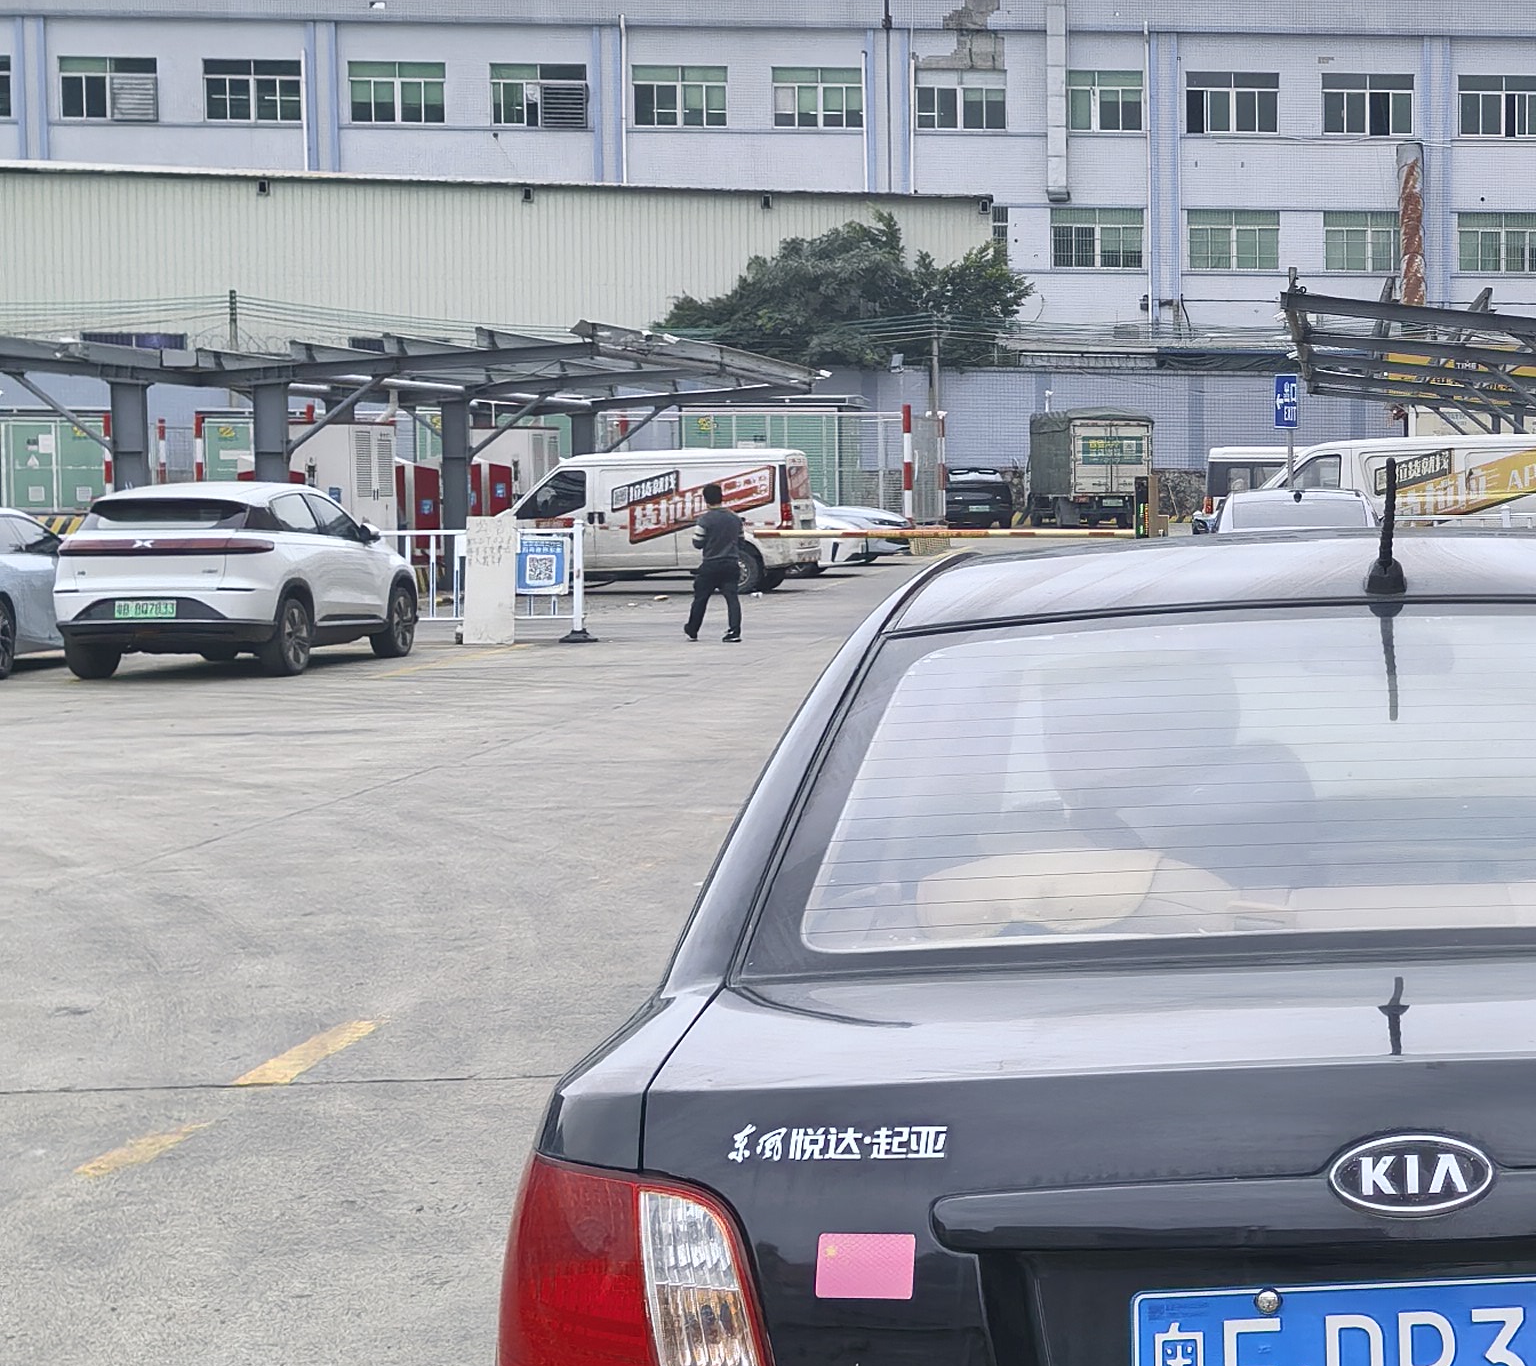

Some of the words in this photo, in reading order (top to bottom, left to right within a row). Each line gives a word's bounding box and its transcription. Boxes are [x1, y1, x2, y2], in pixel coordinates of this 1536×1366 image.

[1283, 381, 1297, 403] 出口
[1283, 405, 1297, 421] EXIT
[1358, 1153, 1469, 1196] KIA
